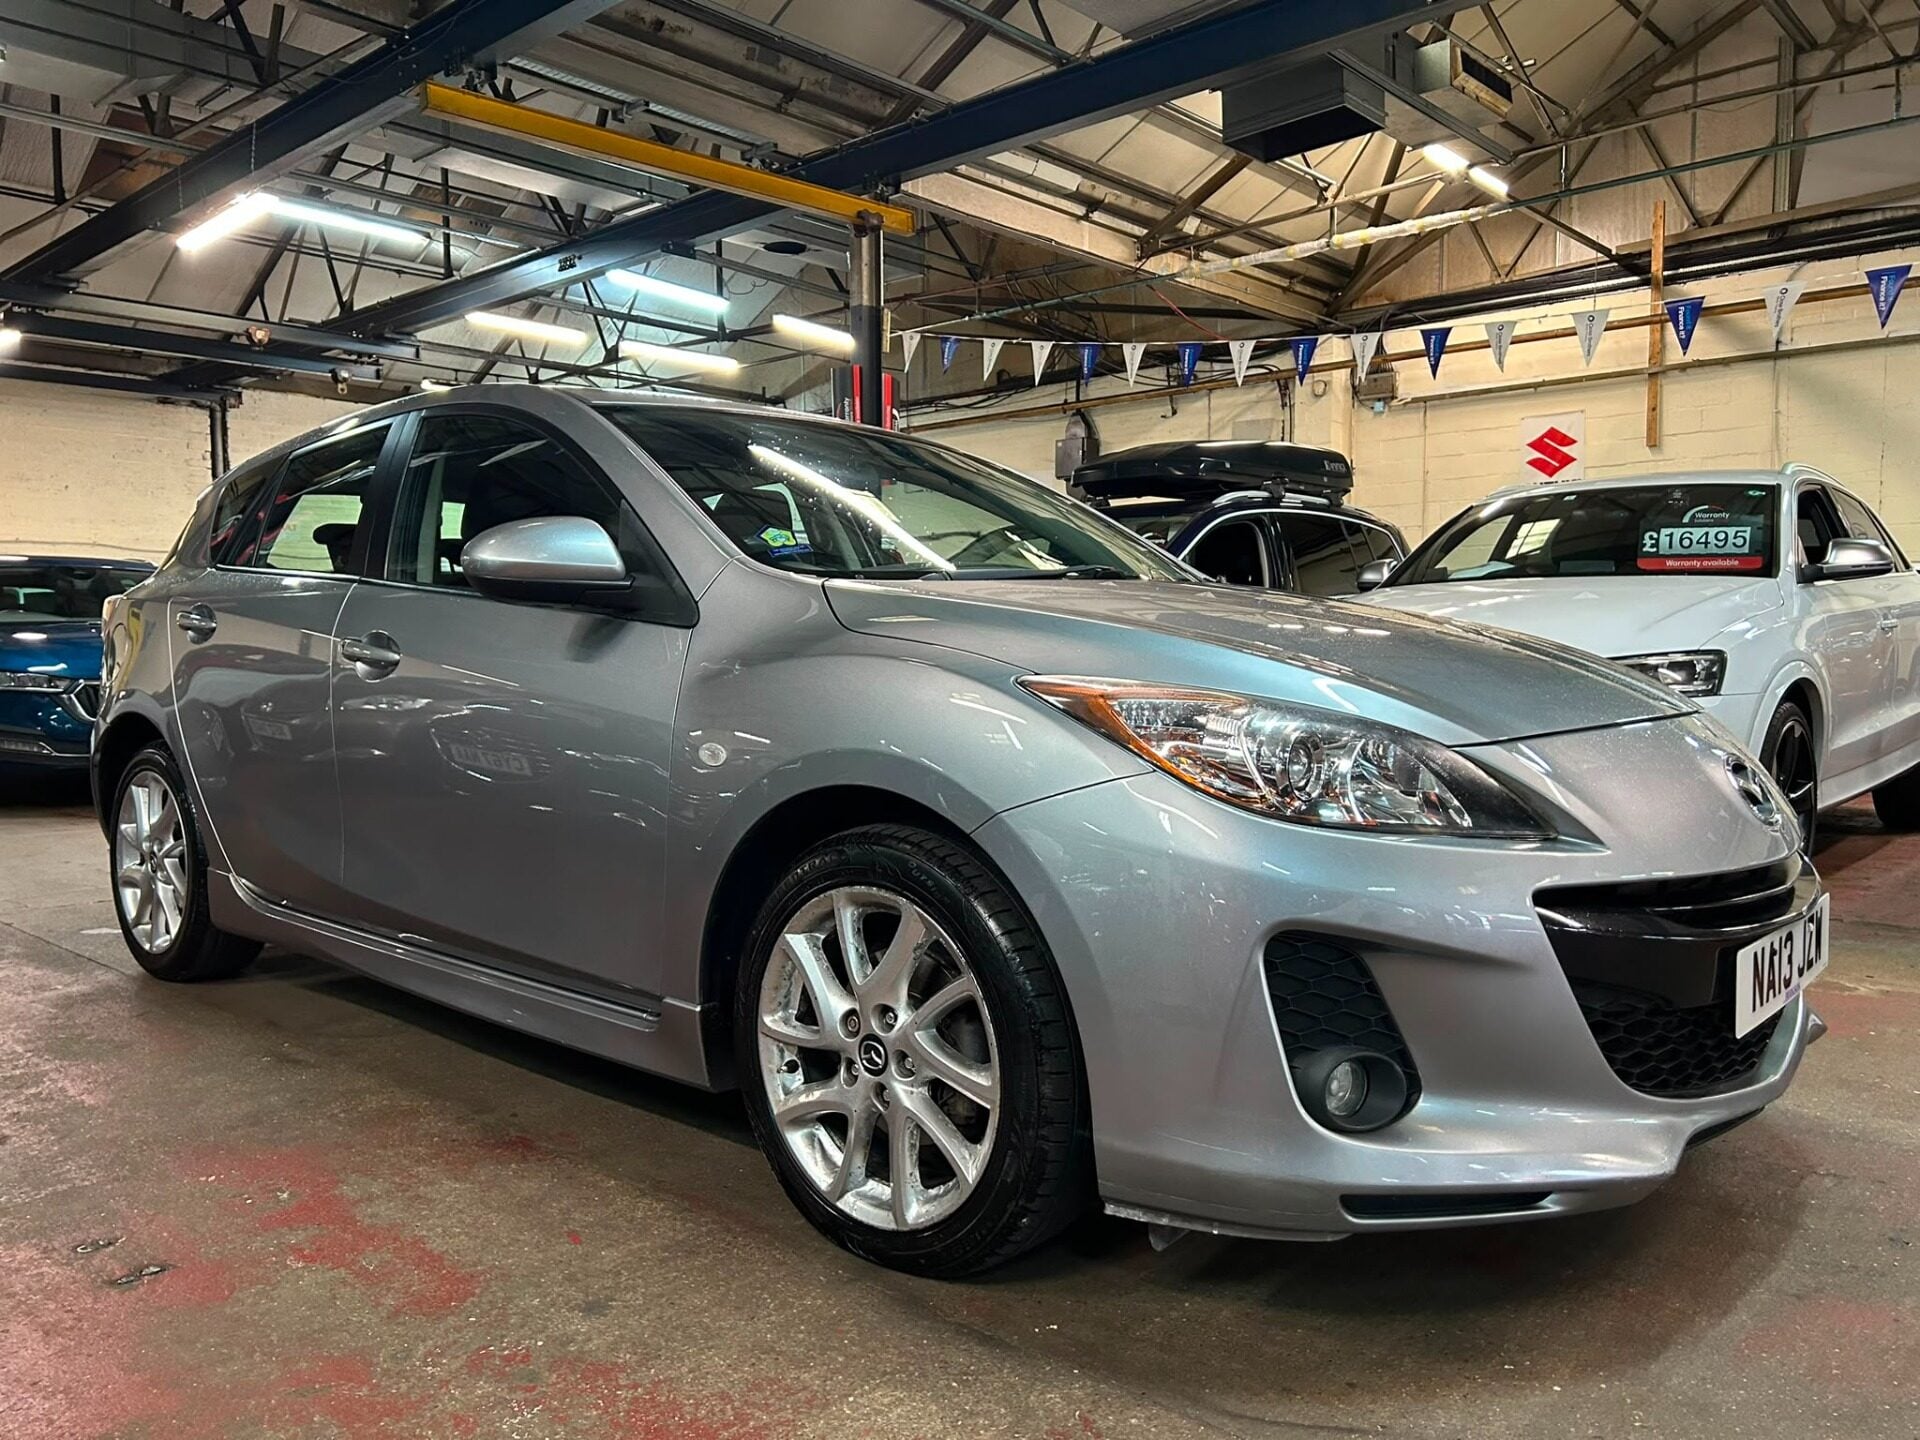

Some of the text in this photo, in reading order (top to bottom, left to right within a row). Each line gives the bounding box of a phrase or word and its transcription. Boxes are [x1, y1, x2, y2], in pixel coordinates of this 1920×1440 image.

[1880, 276, 1888, 302] Finance
[1695, 511, 1730, 519] Warranty
[1642, 530, 1748, 552] £16495
[1665, 558, 1739, 568] Warranty available
[1752, 930, 1793, 1013] NA13
